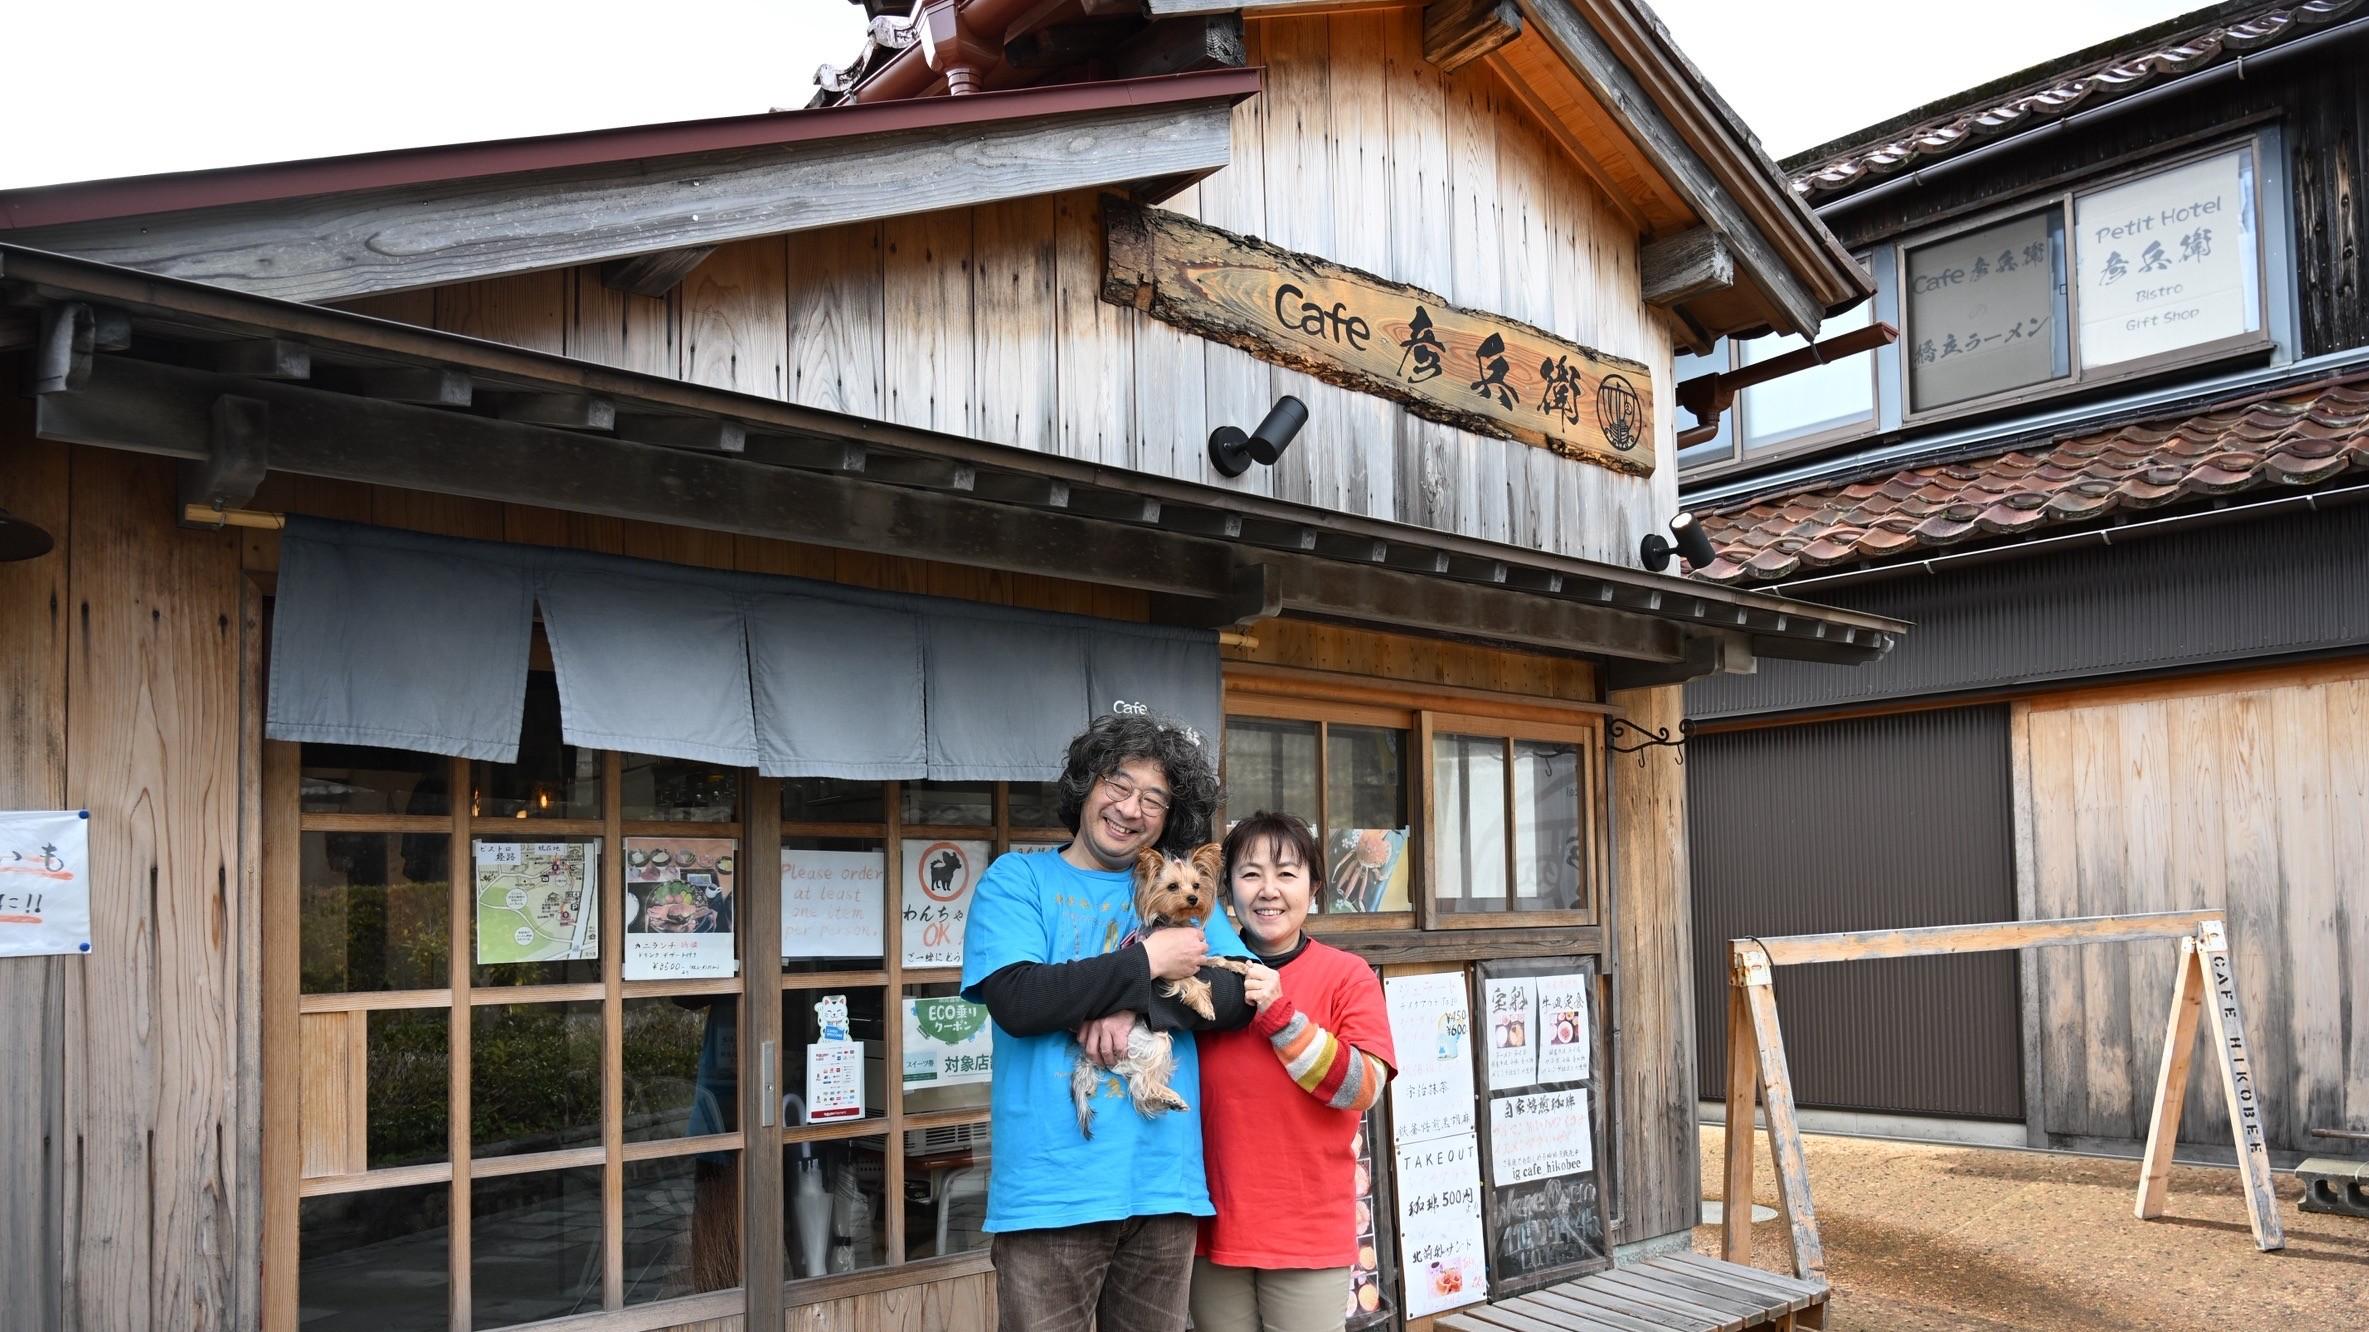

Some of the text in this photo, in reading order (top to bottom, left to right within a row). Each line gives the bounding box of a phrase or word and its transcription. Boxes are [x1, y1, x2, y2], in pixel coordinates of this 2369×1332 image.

[2096, 196, 2223, 244] Petit Hotel
[1913, 265, 1965, 295] Cafe
[2135, 281, 2183, 303] Bistro
[1274, 283, 1371, 352] Cafe
[2126, 305, 2200, 332] Gift Shop
[1113, 699, 1148, 715] Cafe
[780, 863, 883, 880] Please order
[793, 885, 862, 902] at least
[923, 922, 951, 947] OK
[934, 1019, 972, 1032] クーポン
[945, 1053, 993, 1073] 対象店
[2214, 956, 2262, 1153] CAFE HIKOBEE
[1404, 1146, 1474, 1170] TAKEOUT
[1512, 1167, 1521, 1180] ig
